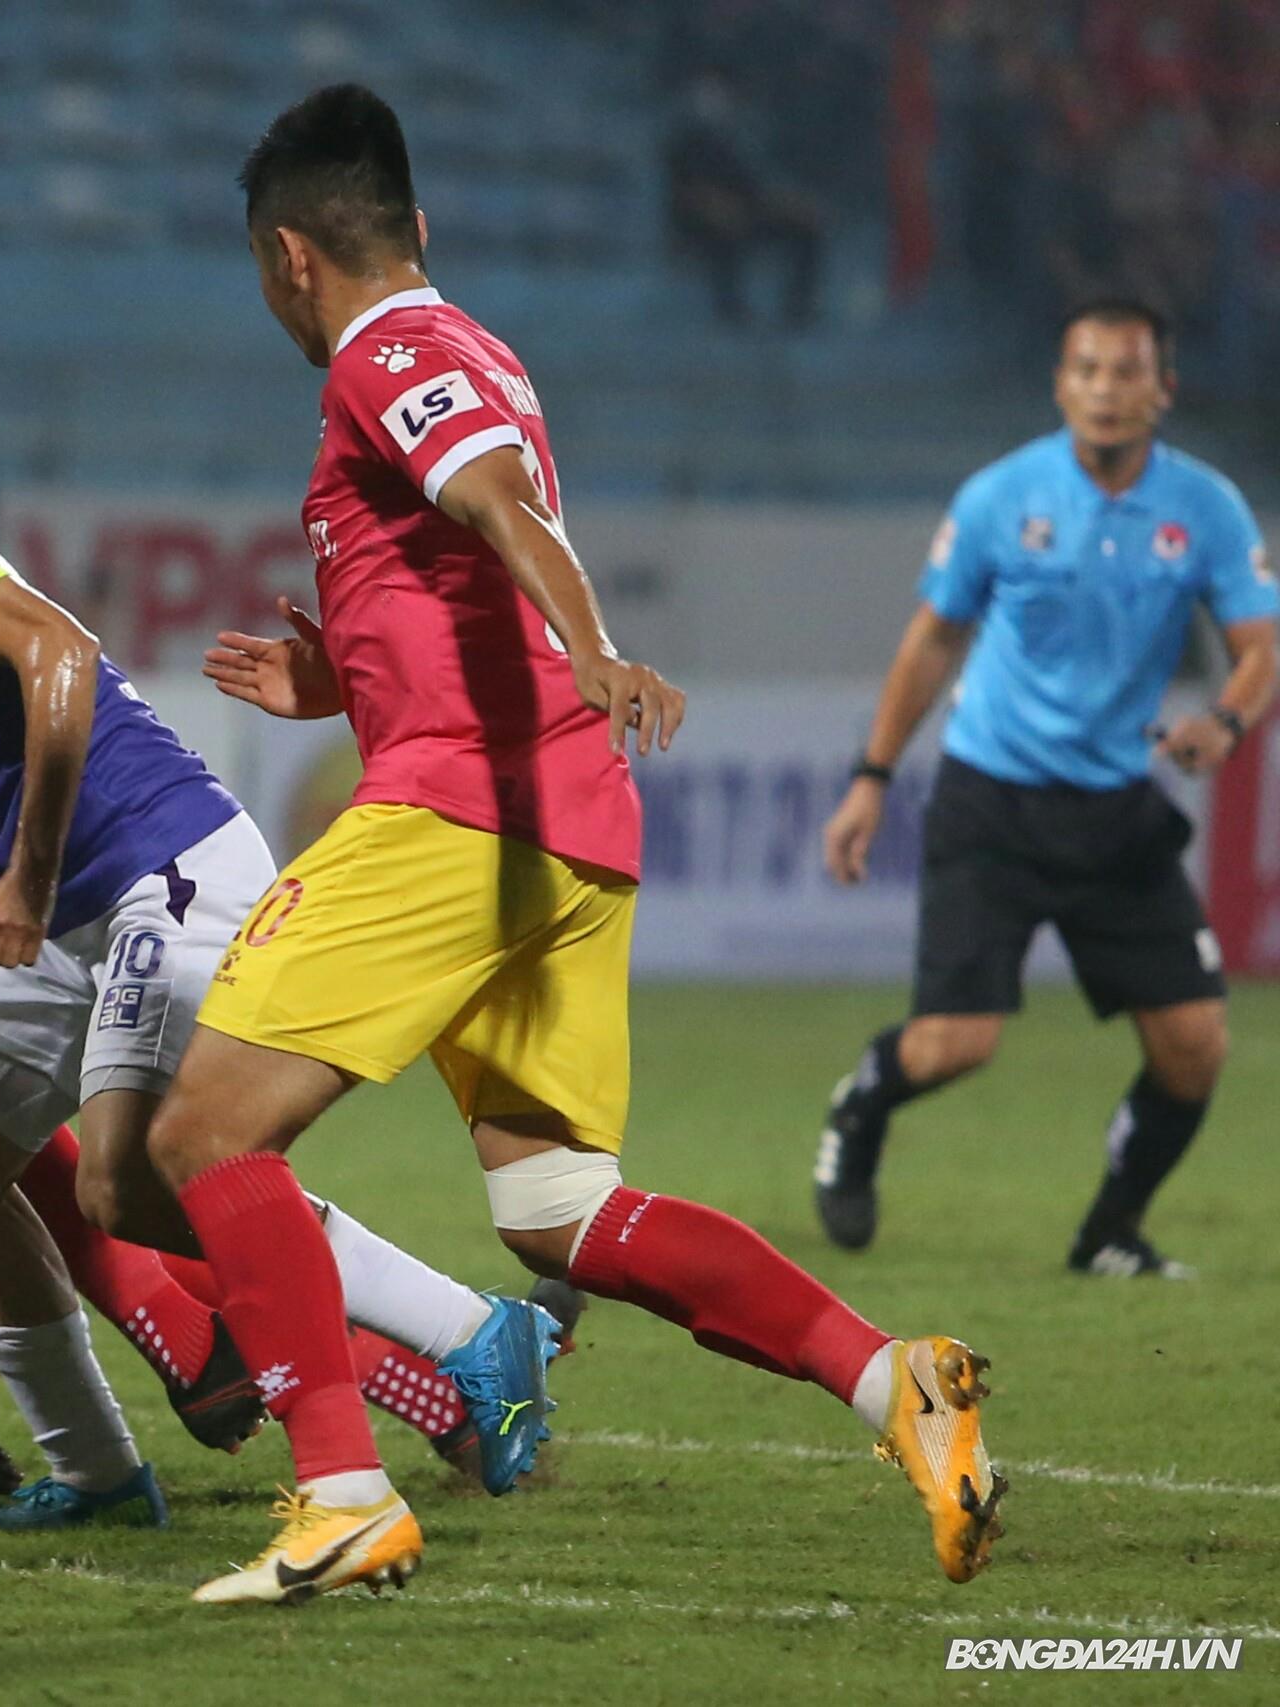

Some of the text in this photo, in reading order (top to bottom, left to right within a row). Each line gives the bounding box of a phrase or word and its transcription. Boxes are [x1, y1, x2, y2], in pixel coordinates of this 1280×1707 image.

[401, 387, 454, 437] LS
[232, 877, 304, 948] 0
[111, 930, 166, 980] 10
